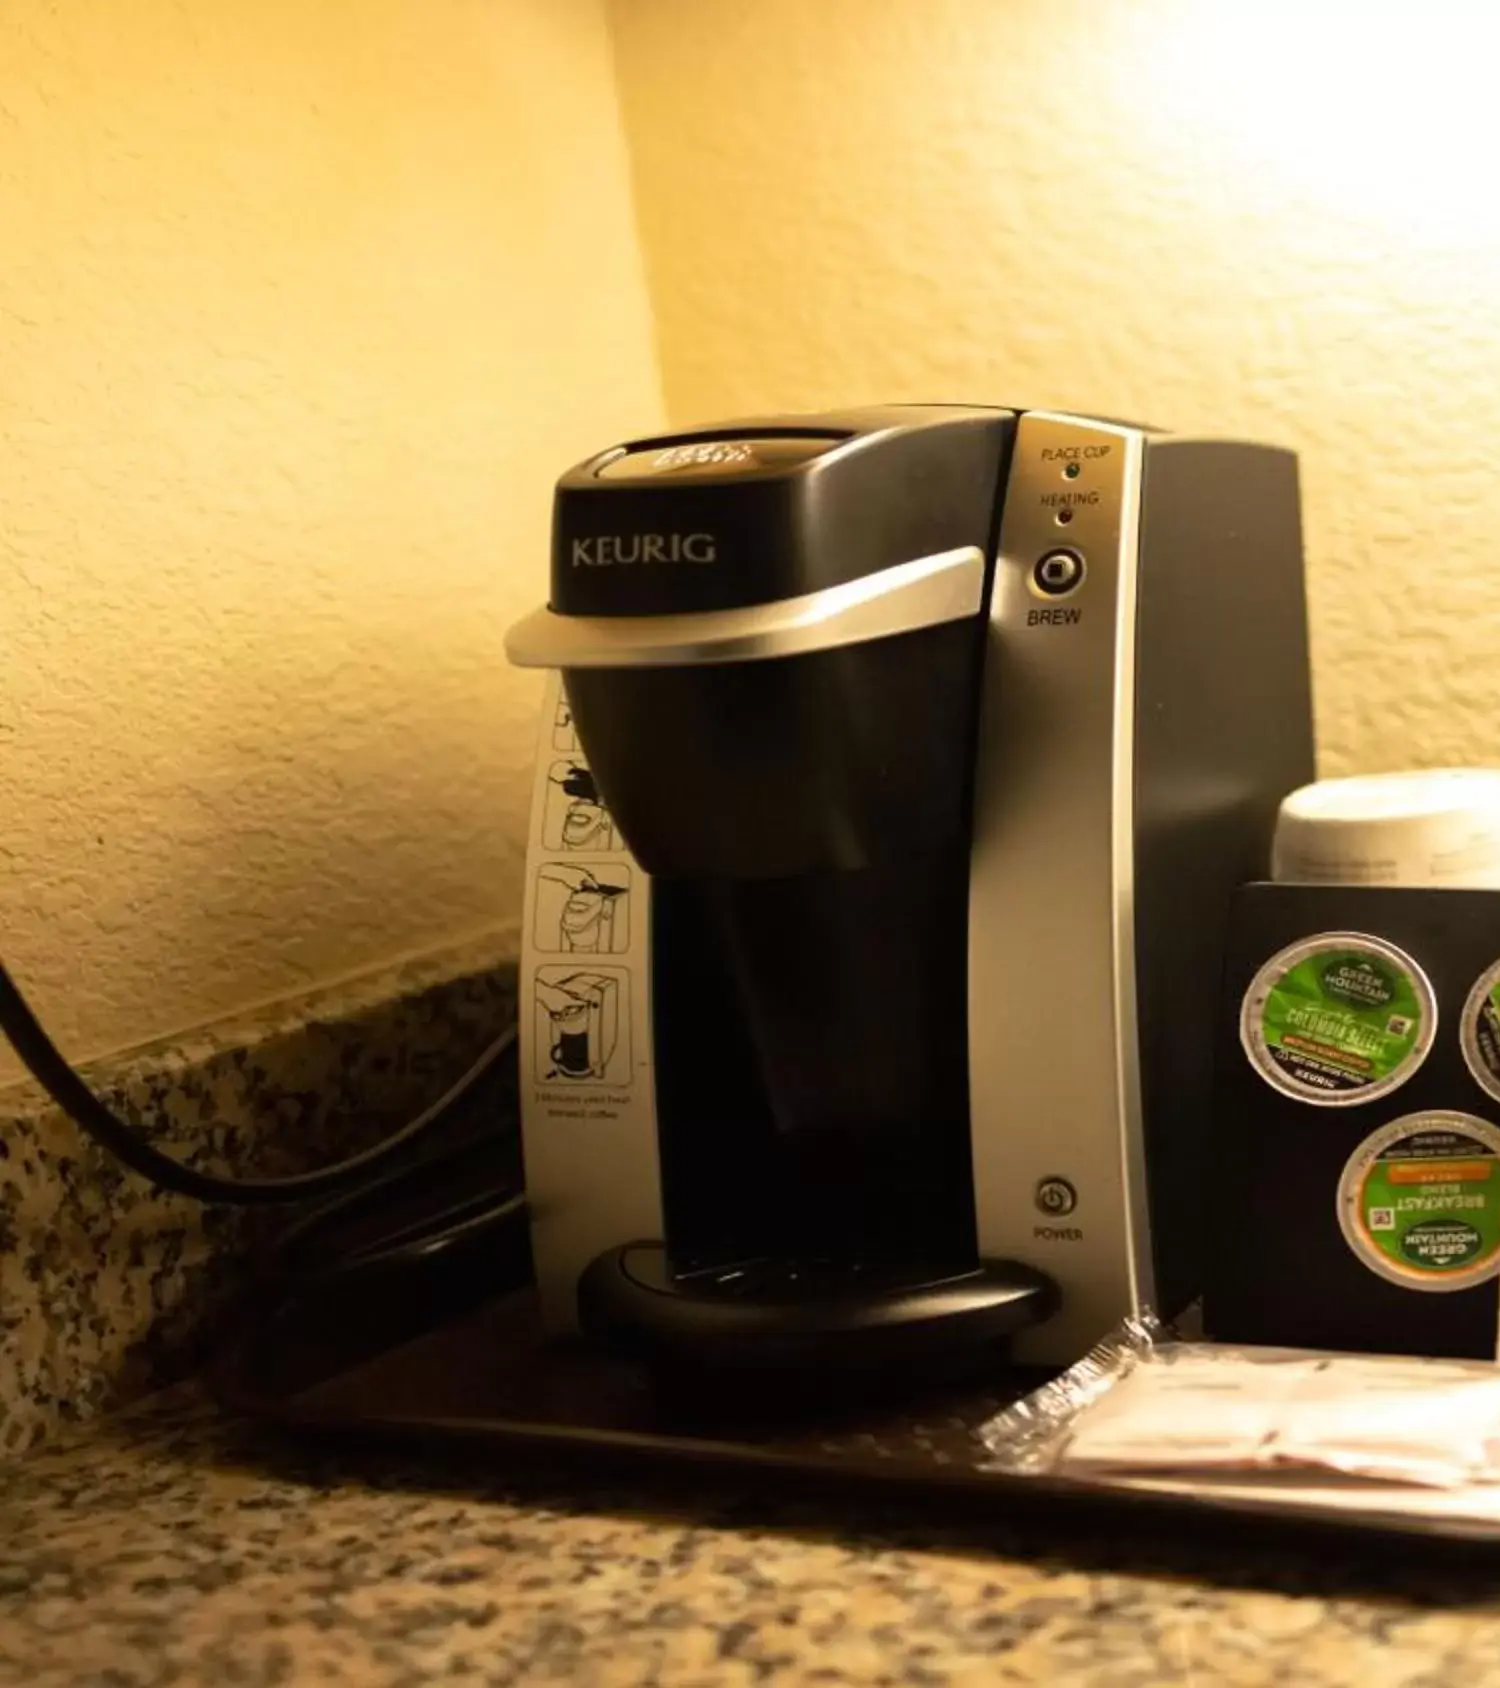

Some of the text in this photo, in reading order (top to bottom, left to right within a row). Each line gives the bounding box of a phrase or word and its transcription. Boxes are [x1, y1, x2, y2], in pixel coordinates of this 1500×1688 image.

[1041, 445, 1111, 461] PLACE CUP
[1040, 491, 1099, 507] HEATING
[572, 532, 716, 567] KEURIG
[1027, 608, 1082, 626] BREW
[1339, 967, 1383, 987] GREEN
[1396, 1194, 1485, 1211] BREAKFAST
[1033, 1225, 1083, 1242] POWER
[1418, 1244, 1467, 1256] GREEN
